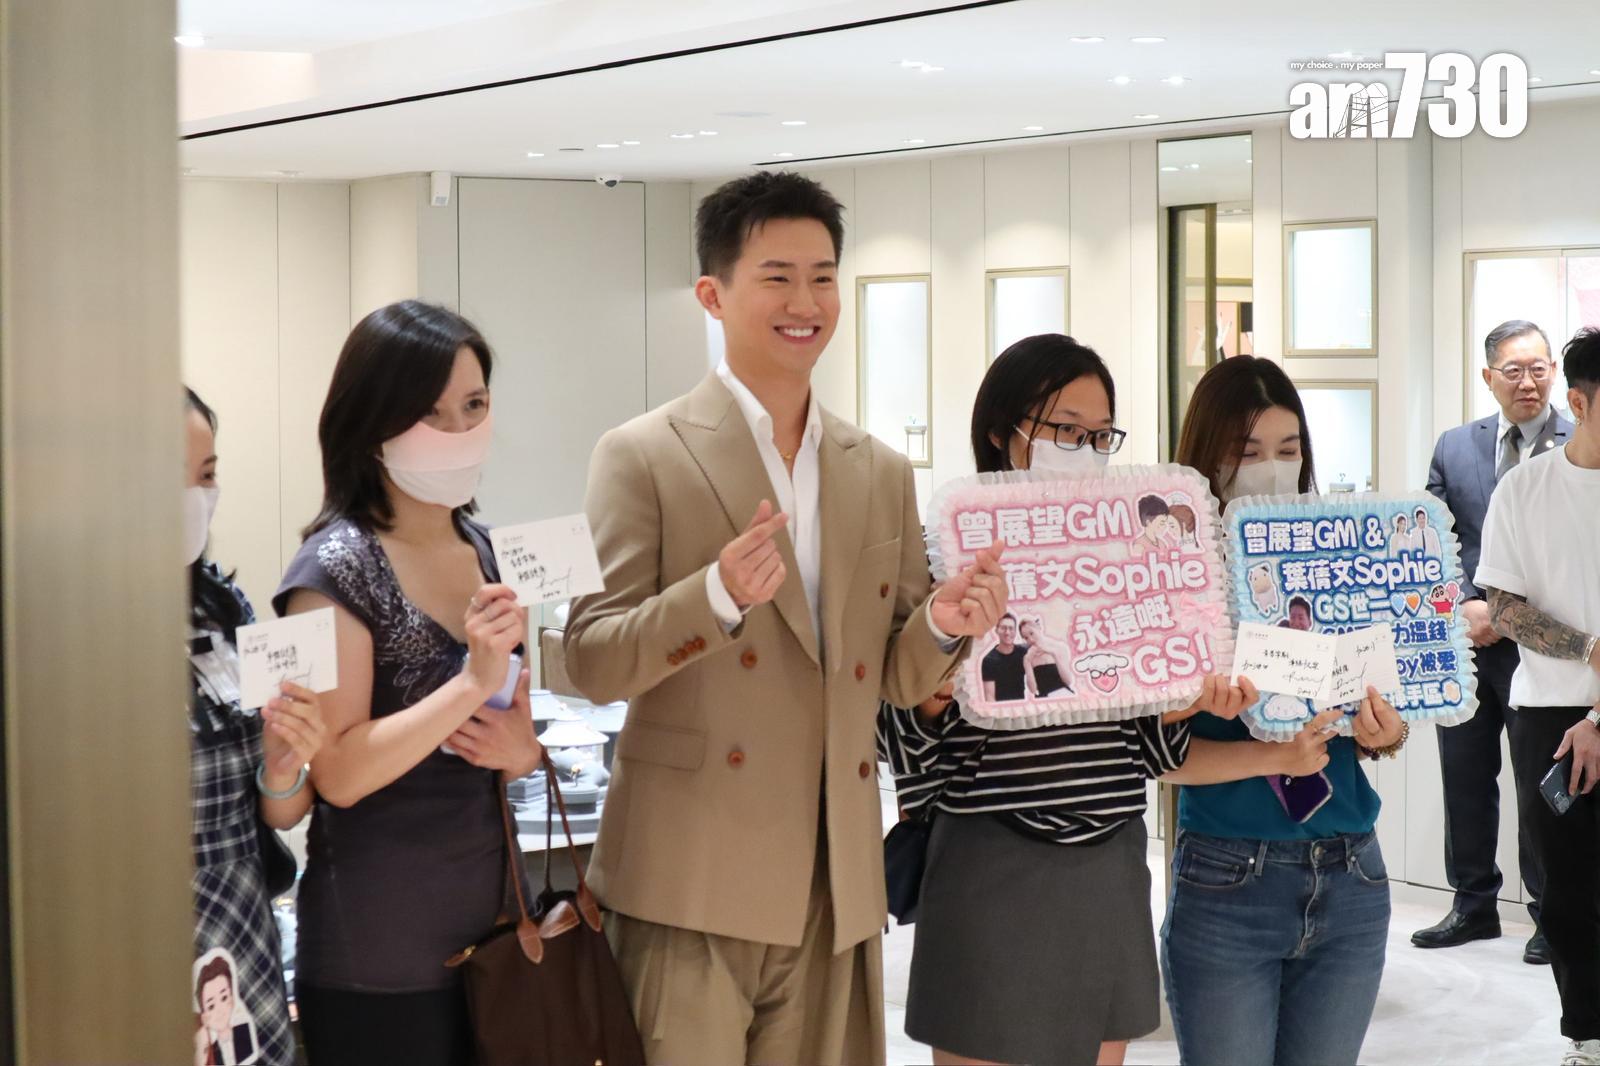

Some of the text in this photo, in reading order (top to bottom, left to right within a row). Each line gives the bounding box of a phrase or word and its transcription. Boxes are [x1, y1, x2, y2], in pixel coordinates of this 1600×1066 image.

[956, 500, 1133, 549] 曾展望GM
[1244, 516, 1385, 553] 曾展望GM &
[963, 551, 1206, 600] 蒨文Sophie
[1073, 594, 1176, 651] 永遠嘅
[1134, 632, 1212, 684] GS!
